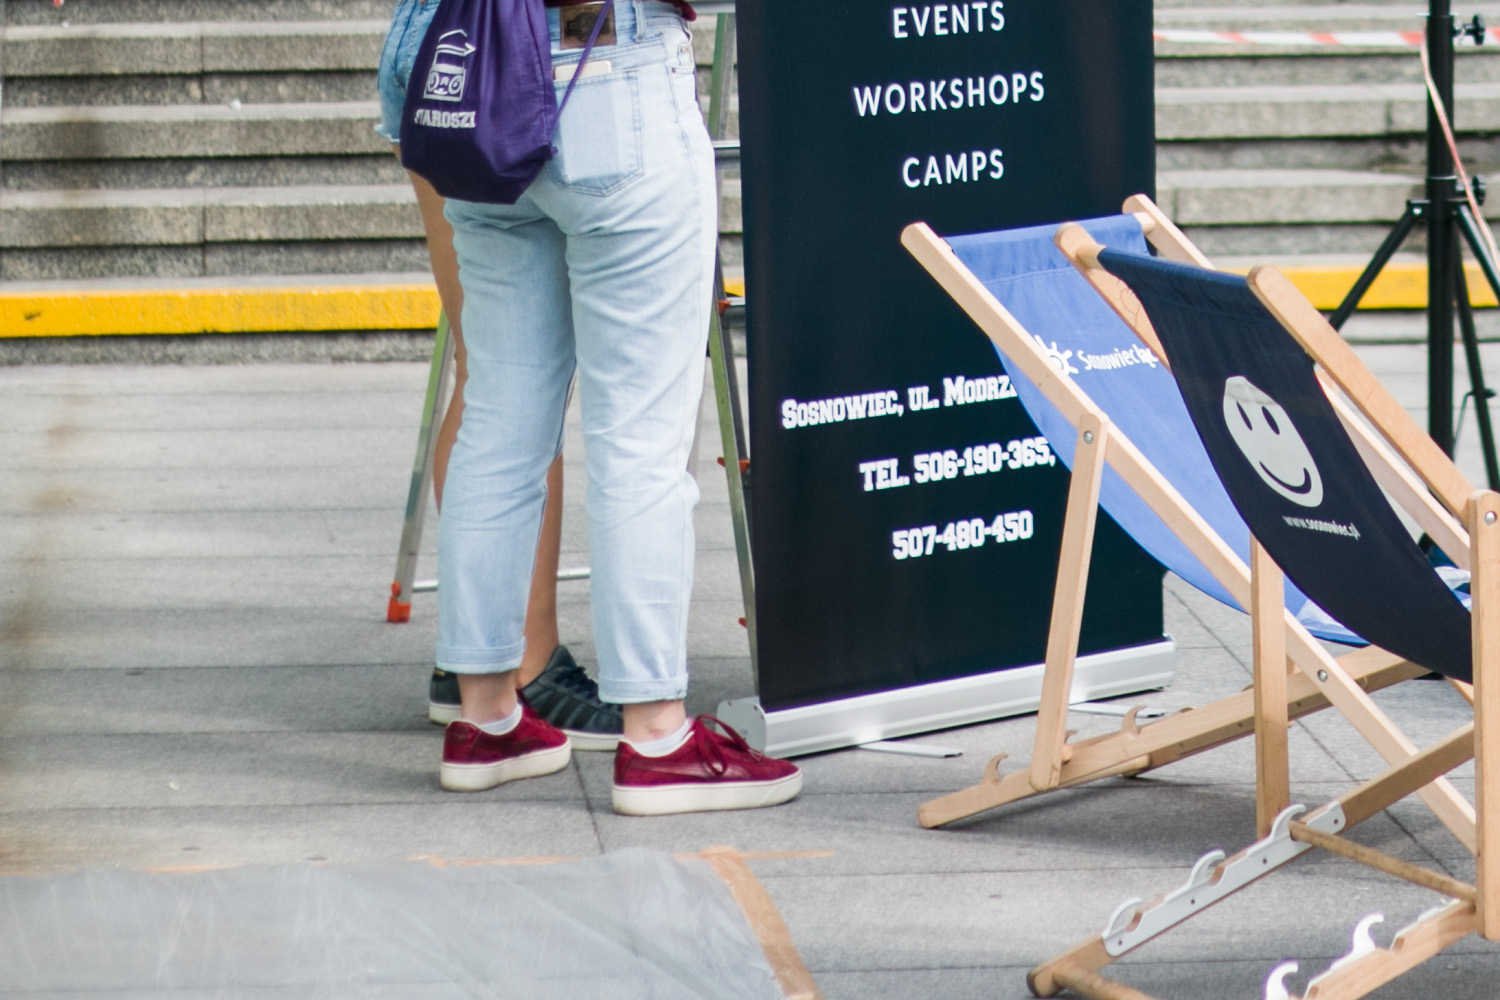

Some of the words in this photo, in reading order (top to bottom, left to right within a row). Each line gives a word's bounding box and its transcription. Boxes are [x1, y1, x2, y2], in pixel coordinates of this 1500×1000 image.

[892, 0, 1005, 39] EVENTS
[853, 71, 1045, 117] WORKSHOPS
[902, 148, 1004, 188] CAMPS
[859, 458, 911, 491] TEL.
[913, 437, 1057, 484] 506-190-365,
[892, 510, 1034, 560] 507-480-450
